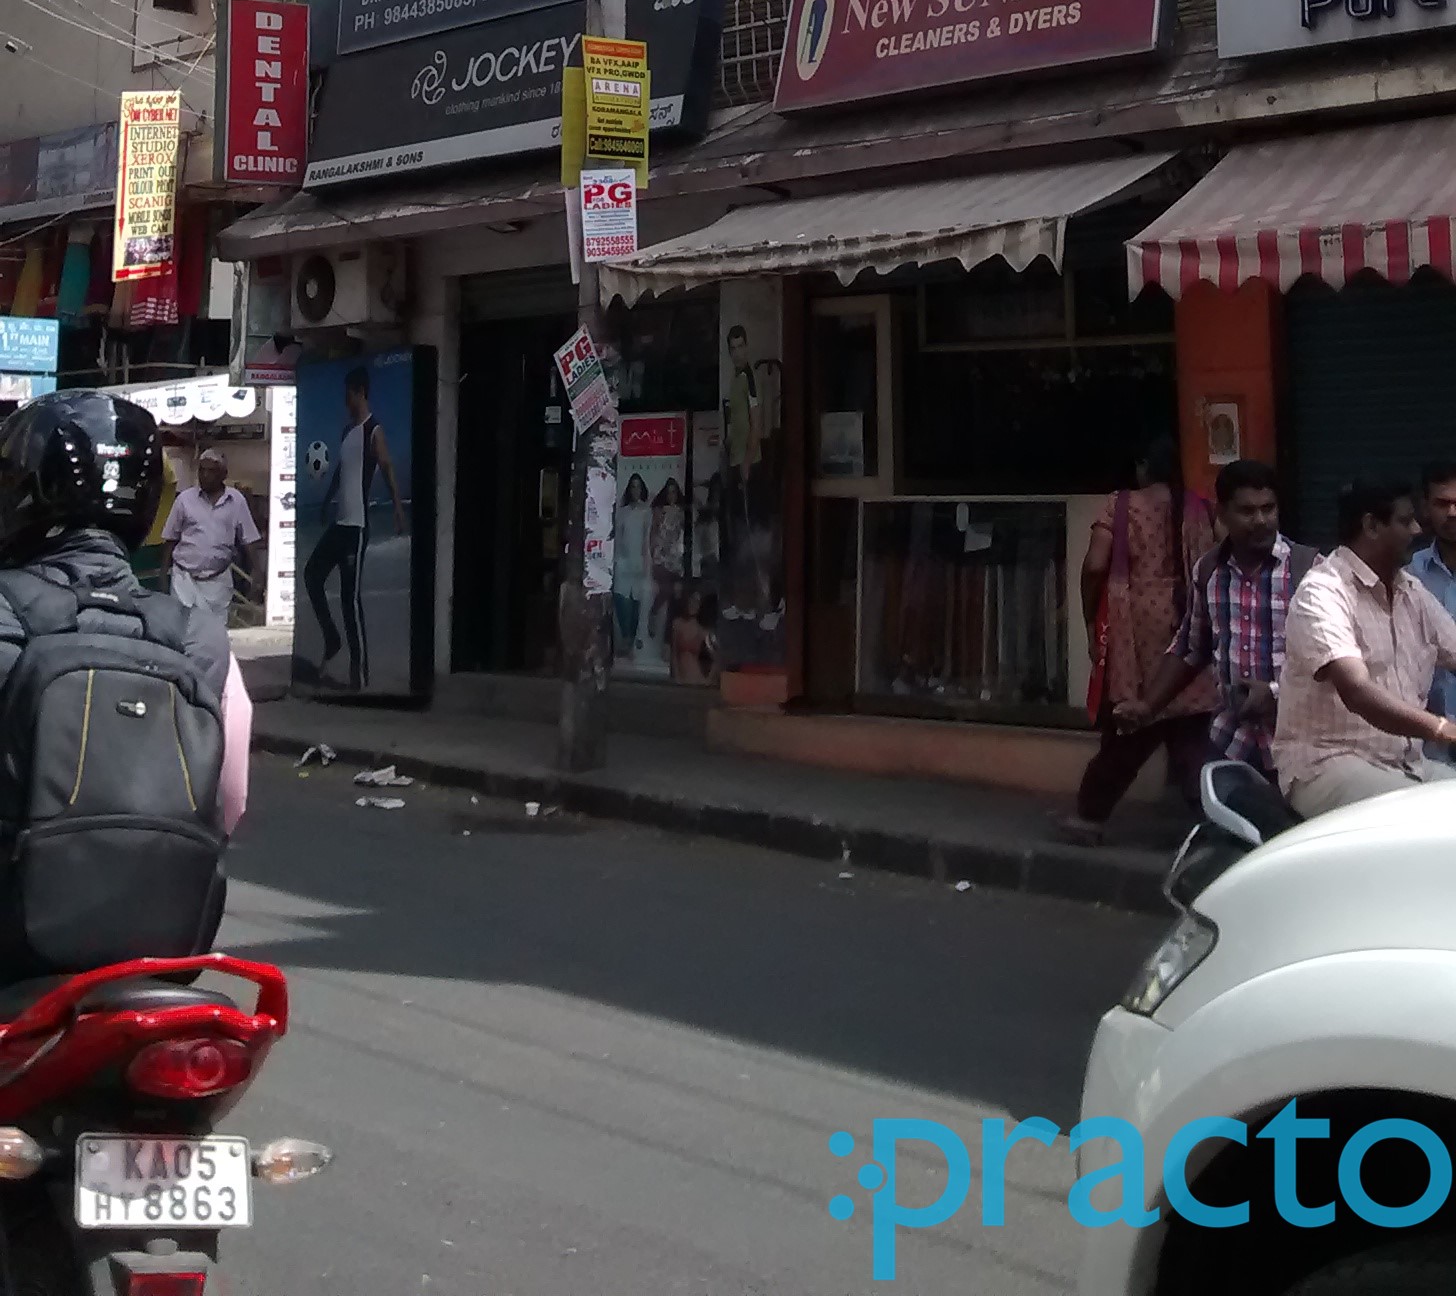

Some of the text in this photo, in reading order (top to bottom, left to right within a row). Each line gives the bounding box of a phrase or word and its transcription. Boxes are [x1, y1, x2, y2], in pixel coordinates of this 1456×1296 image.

[876, 2, 1082, 59] CLEANERS & DYERS
[451, 32, 582, 92] JOCKEY
[253, 11, 283, 151] DENTAL
[522, 85, 547, 99] since
[550, 81, 563, 95] 18
[595, 81, 639, 94] ARENA
[130, 126, 178, 140] INTERNET
[131, 140, 176, 153] STUDIO
[132, 152, 174, 165] XEROX
[233, 154, 298, 173] CLINIC
[308, 150, 424, 181] RANGALAKSHMI & SONS
[129, 165, 176, 179] PRINT OUT
[128, 195, 172, 209] SCANIG
[583, 183, 632, 204] PG
[583, 202, 632, 210] LADIES
[131, 224, 168, 235] WEB CAM
[20, 334, 49, 347] MAIN
[560, 335, 592, 376] PG
[566, 354, 596, 386] LADIES
[123, 1139, 217, 1181] KA05
